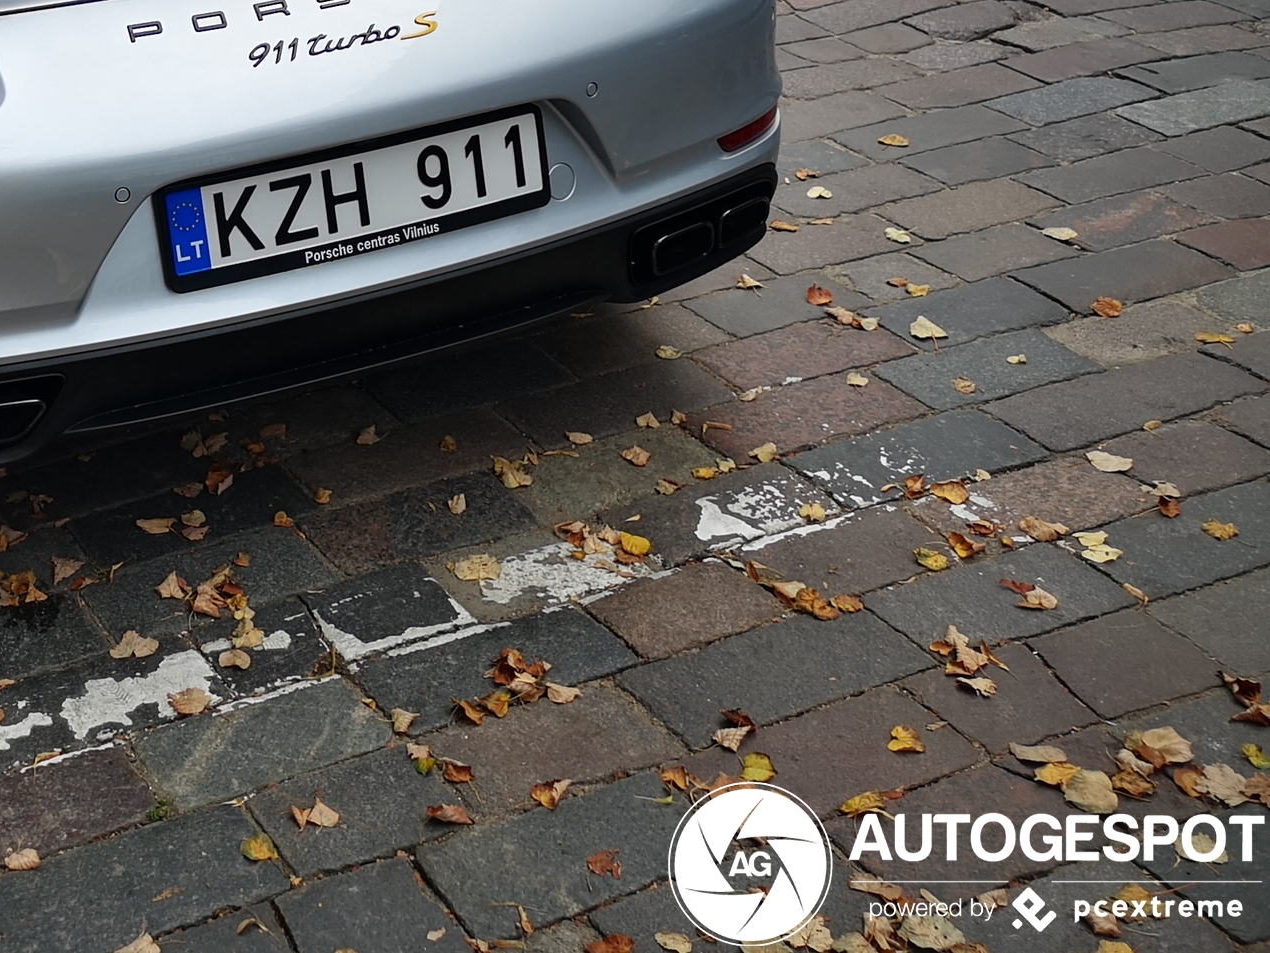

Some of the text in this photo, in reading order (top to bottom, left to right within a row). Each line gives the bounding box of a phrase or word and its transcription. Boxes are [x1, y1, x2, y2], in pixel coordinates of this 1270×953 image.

[248, 37, 300, 68] 911
[306, 23, 402, 57] turbo
[175, 124, 527, 262] LT KZH 911
[304, 221, 440, 264] Porsche centras Vilnius
